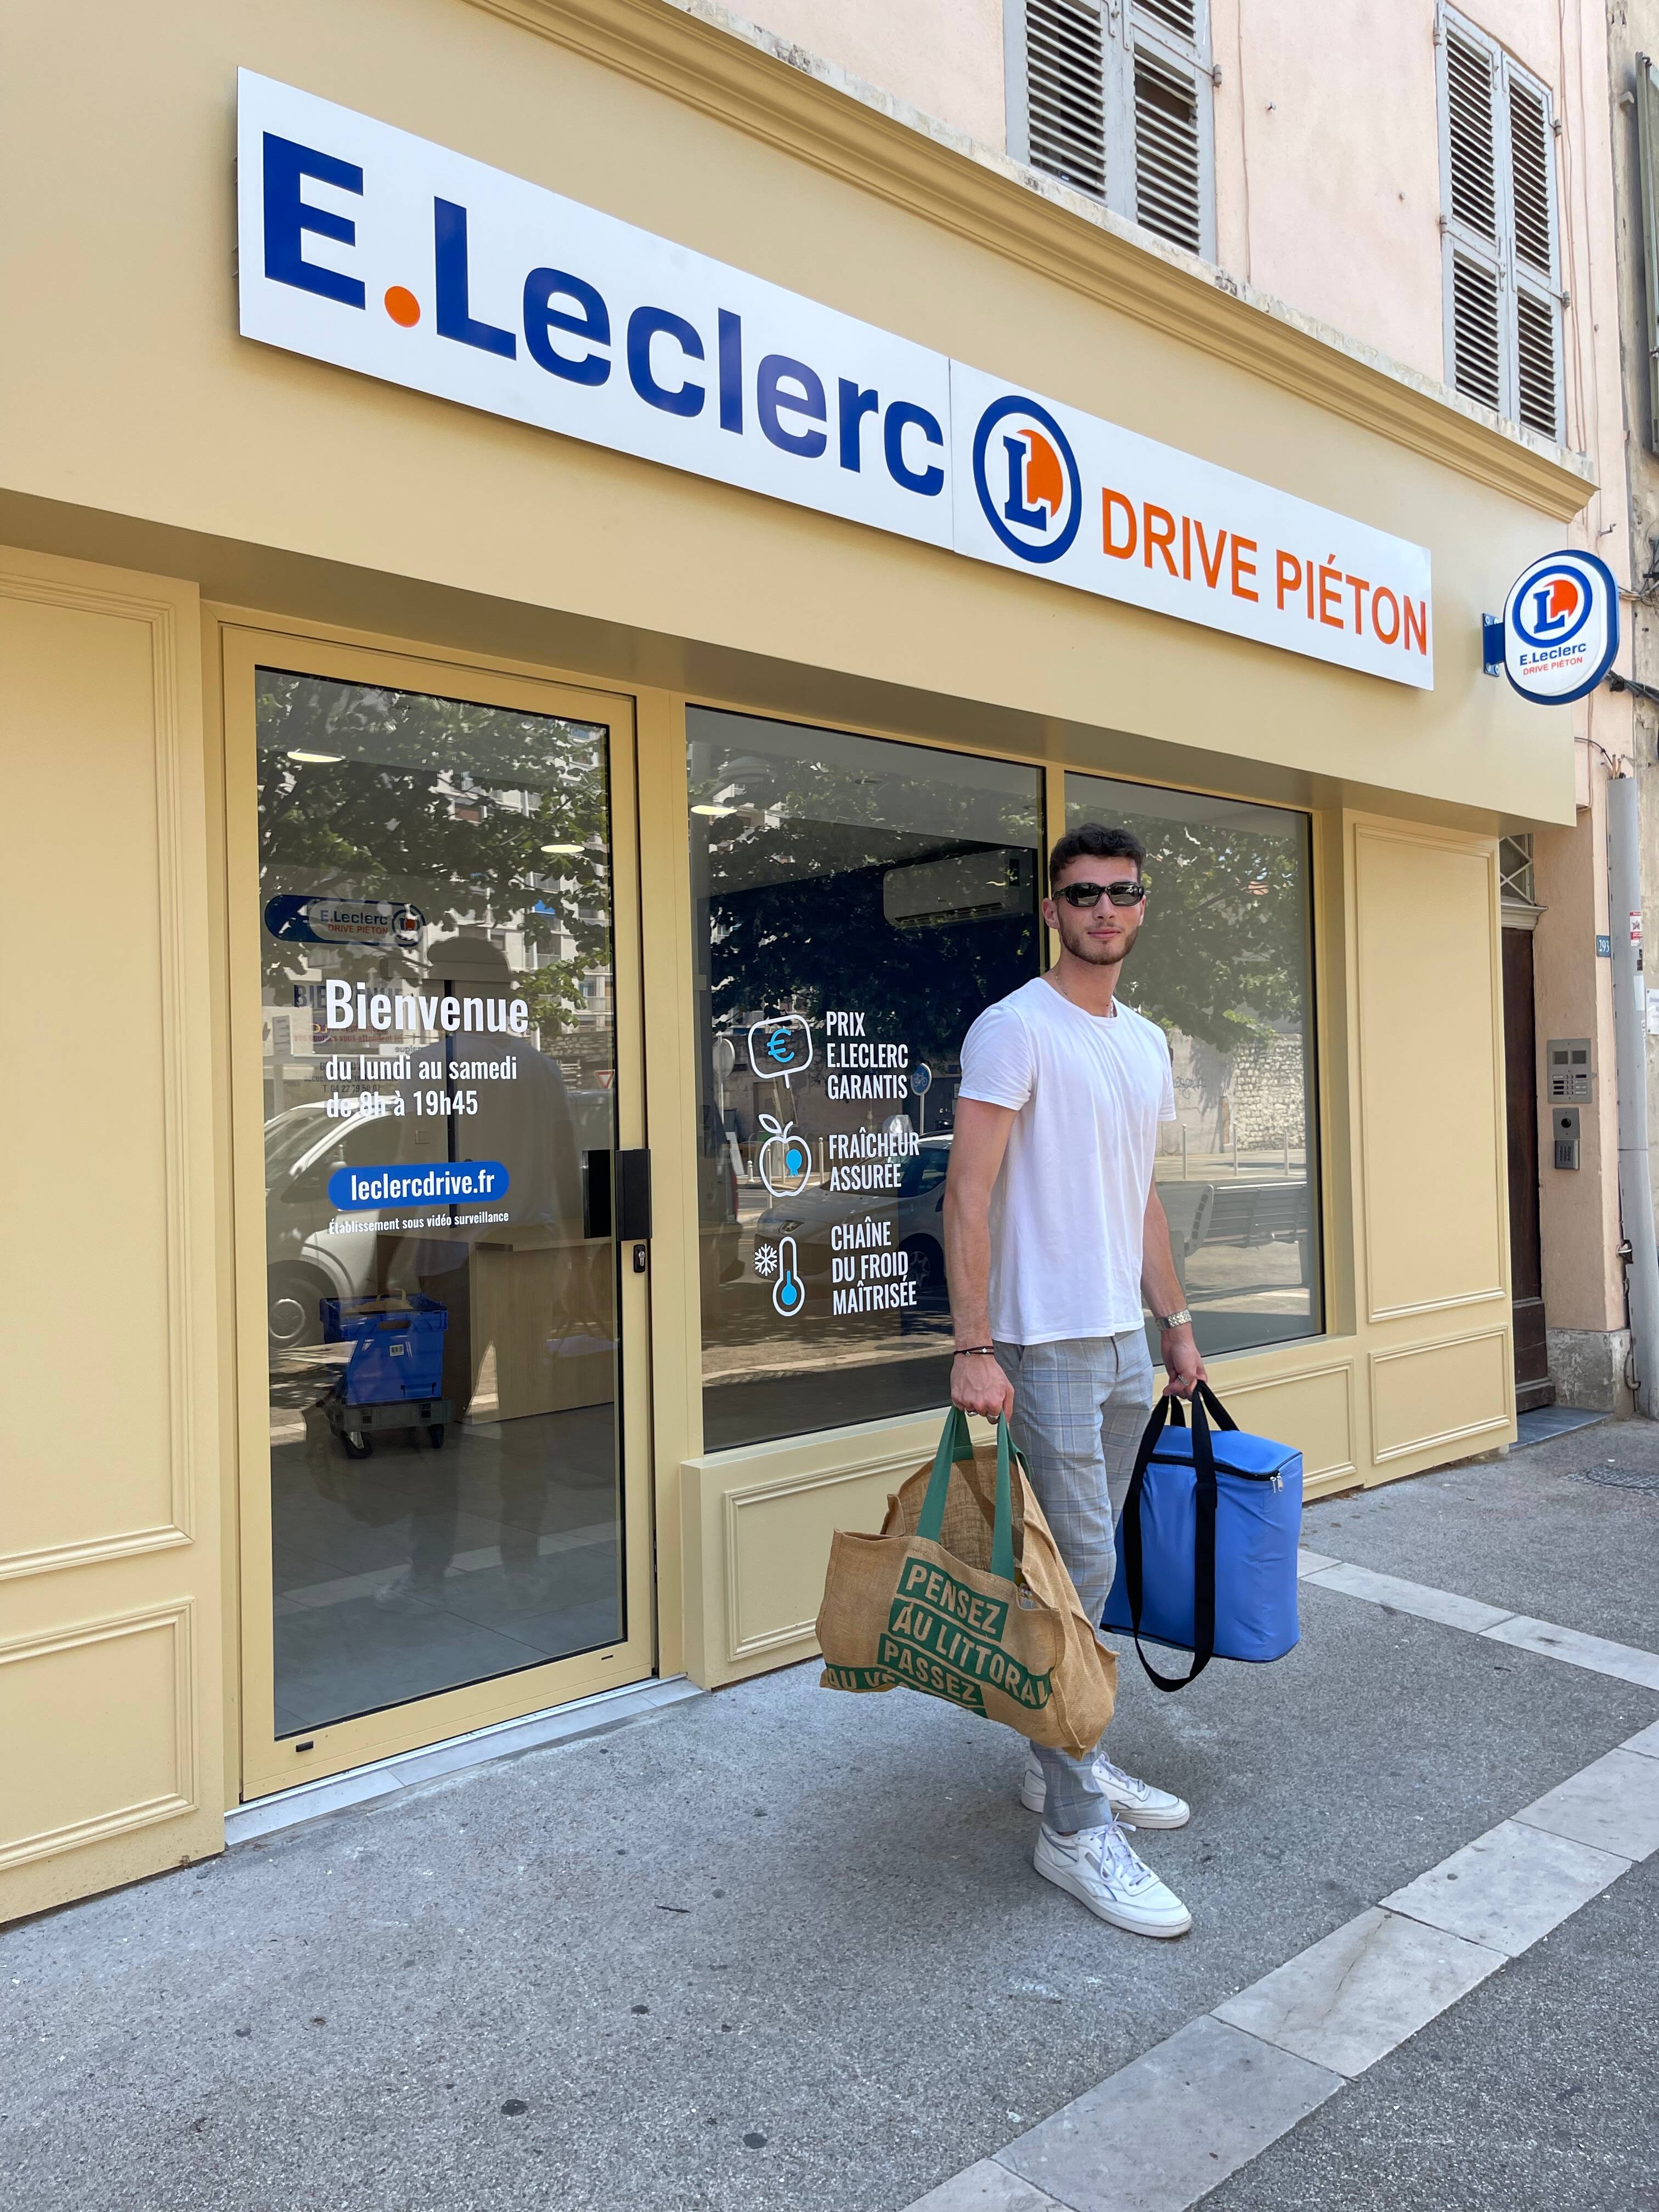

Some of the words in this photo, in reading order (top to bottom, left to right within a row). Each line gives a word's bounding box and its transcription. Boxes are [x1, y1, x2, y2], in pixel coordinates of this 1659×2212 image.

[263, 131, 944, 496] E.Leclerc
[1102, 487, 1259, 602] DRIVE
[1276, 549, 1427, 656] PIÉTON
[1520, 643, 1587, 666] E.Leclerc
[1523, 663, 1549, 676] DRIVE
[1551, 656, 1583, 669] PIÉTON
[320, 910, 388, 925] E.Leclerc
[328, 923, 354, 933] DRIVE
[357, 924, 388, 934] PIÉTON
[1599, 939, 1610, 953] 293
[326, 979, 529, 1033] Bienvenue
[826, 1011, 866, 1037] PRIX
[326, 1054, 352, 1080] du
[360, 1054, 411, 1080] lundi
[419, 1060, 443, 1081] au
[449, 1056, 517, 1081] samedi
[827, 1043, 909, 1069] E.LECLERC
[331, 1084, 339, 1093] 04
[341, 1084, 350, 1093] 22
[827, 1074, 908, 1099] GARANTIS
[326, 1092, 352, 1118] de
[359, 1091, 386, 1117] 8h
[393, 1090, 405, 1116] à
[413, 1090, 478, 1116] 19h45
[829, 1126, 919, 1159] FRAÎCHEUR
[351, 1170, 495, 1201] leclercdrive.fr
[830, 1157, 901, 1192] ASSURÉE
[329, 1218, 399, 1234] Établissement
[402, 1218, 425, 1229] sous
[426, 1214, 452, 1227] vidéo
[454, 1211, 509, 1225] surveillance
[831, 1216, 891, 1251] CHAÎNE
[832, 1256, 856, 1283] DU
[861, 1251, 909, 1280] FROID
[832, 1274, 917, 1316] MAÎTRISÉE
[905, 1564, 1000, 1634] PENSEZ
[892, 1602, 933, 1641] AU
[826, 1668, 858, 1690] AU
[884, 1639, 977, 1702] PASSEZ
